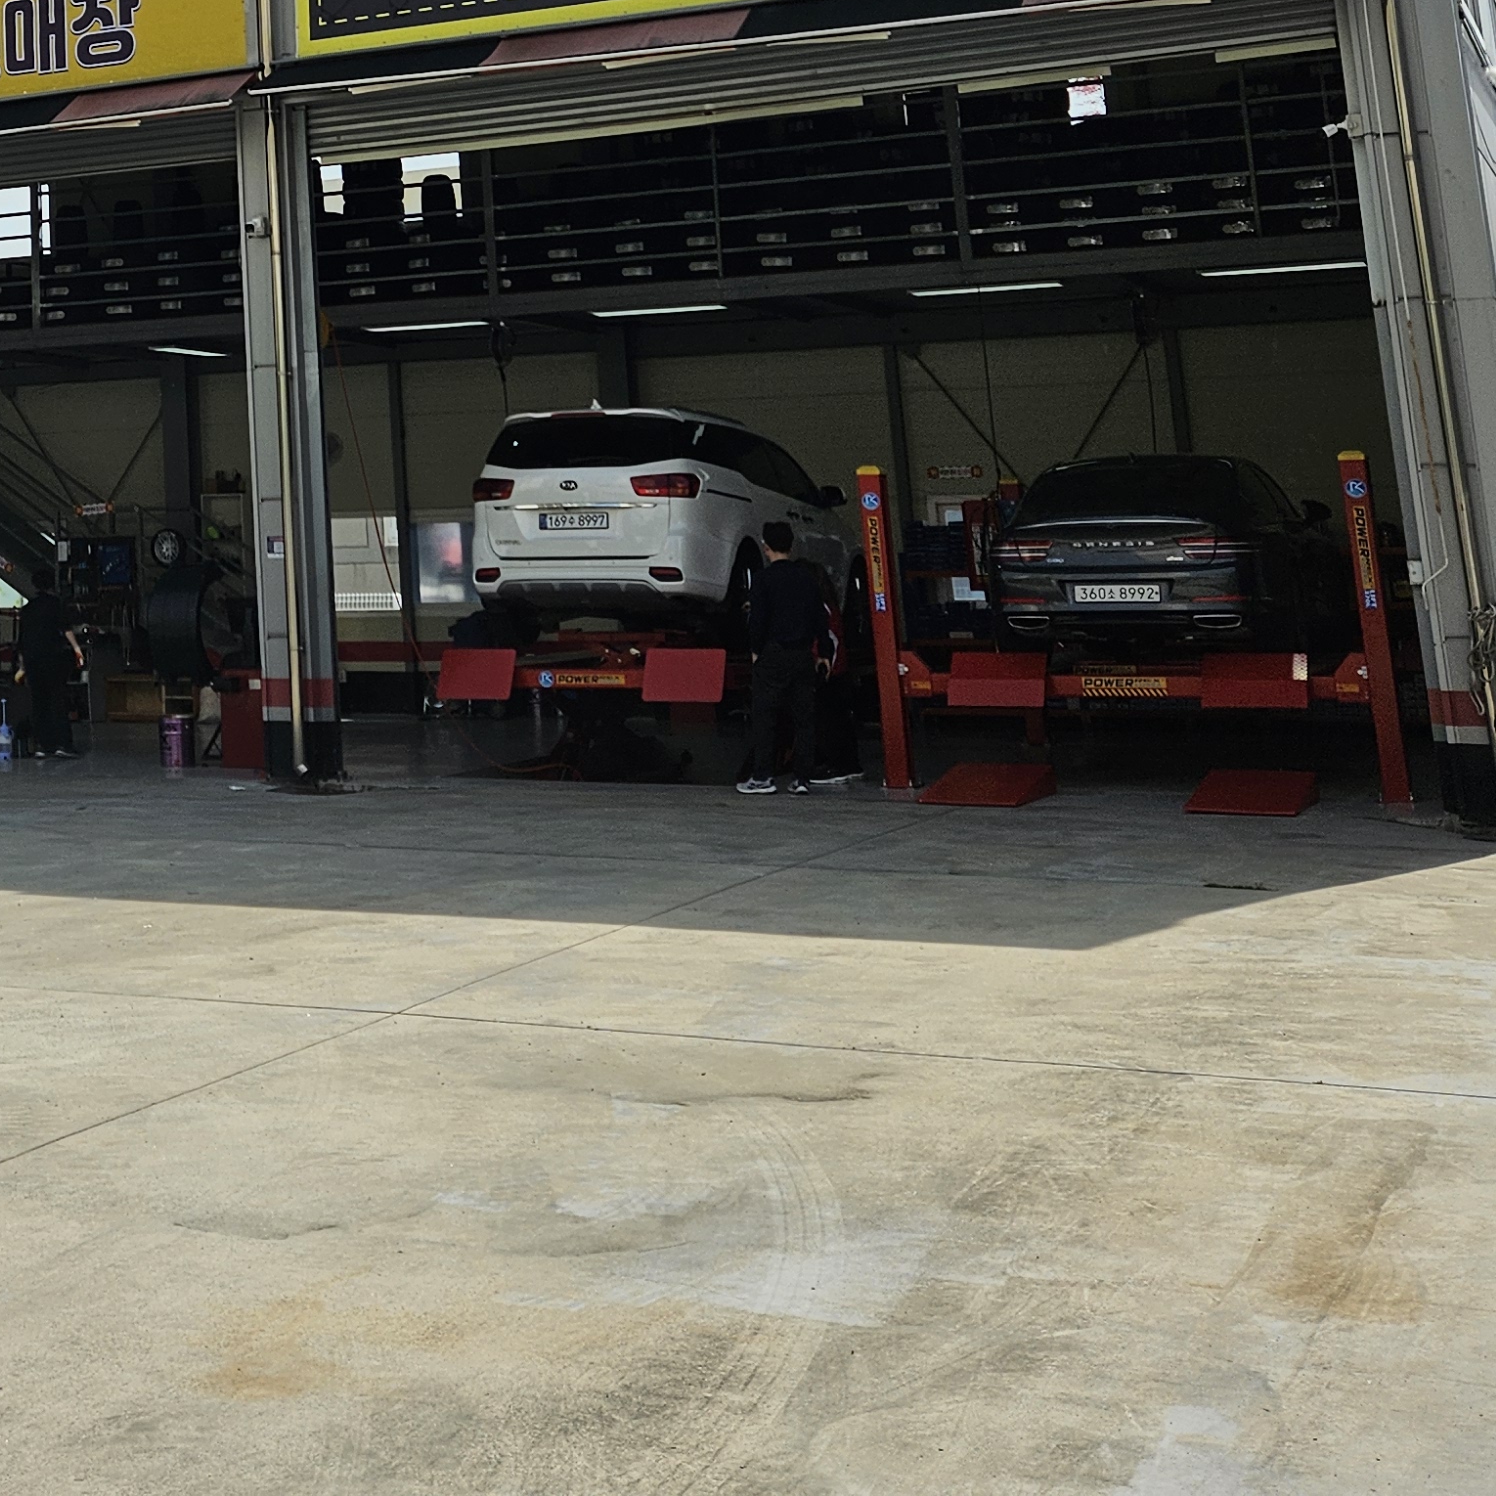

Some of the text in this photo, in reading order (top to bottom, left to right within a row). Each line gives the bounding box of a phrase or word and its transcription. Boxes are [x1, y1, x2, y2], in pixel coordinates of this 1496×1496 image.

[578, 514, 606, 527] 8997
[1080, 587, 1155, 600] 360소 8992
[557, 674, 599, 684] POWER
[1084, 678, 1135, 688] POWER
